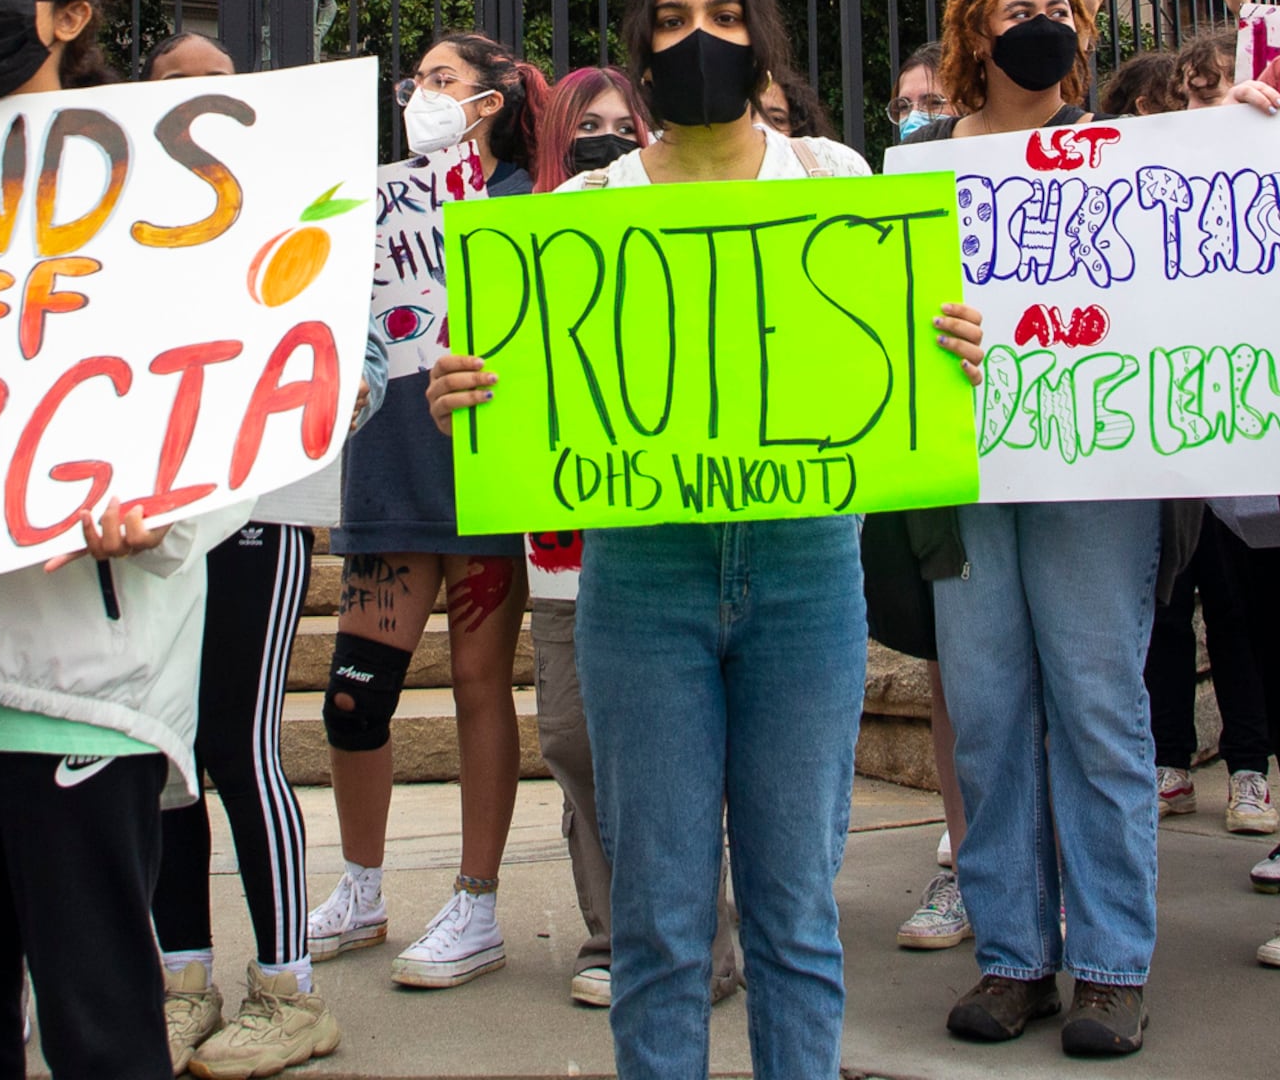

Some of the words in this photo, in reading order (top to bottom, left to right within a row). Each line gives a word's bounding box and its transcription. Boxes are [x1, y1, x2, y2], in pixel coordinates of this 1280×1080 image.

[1026, 126, 1121, 172] LET
[460, 208, 950, 455] PROTEST
[1013, 303, 1111, 349] AND
[553, 446, 662, 512] (DHS
[671, 452, 857, 513] WALKOUT)
